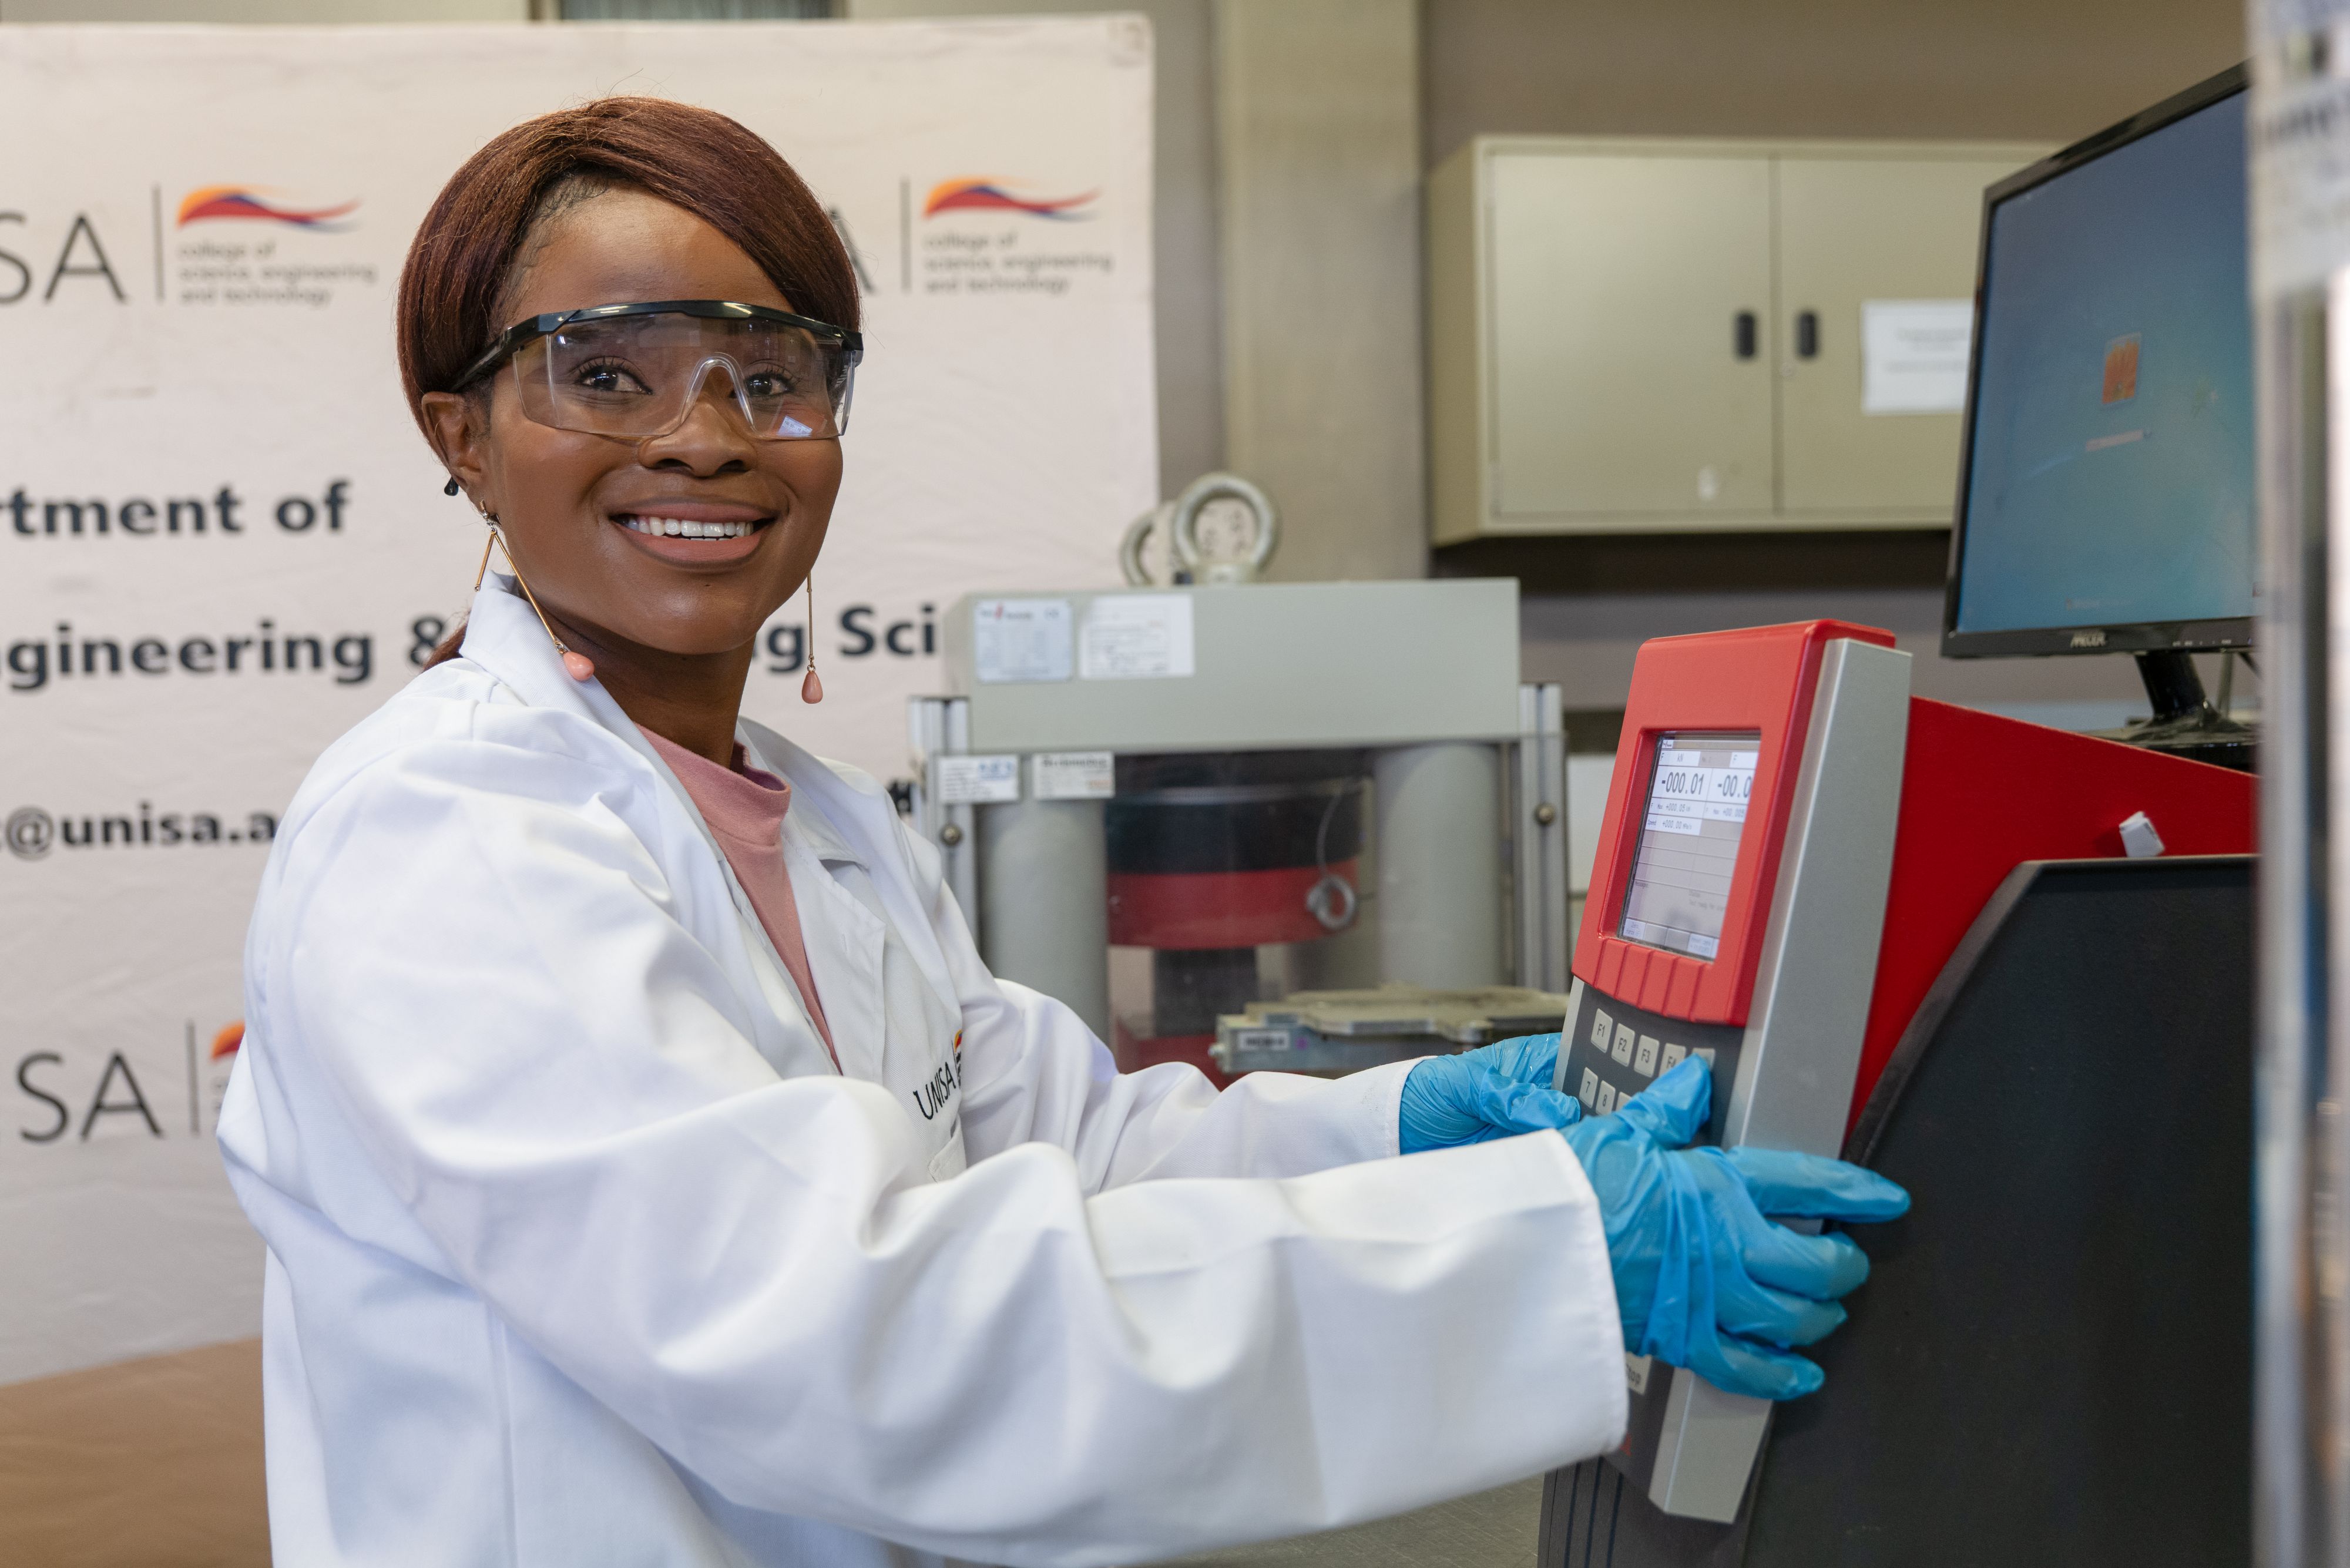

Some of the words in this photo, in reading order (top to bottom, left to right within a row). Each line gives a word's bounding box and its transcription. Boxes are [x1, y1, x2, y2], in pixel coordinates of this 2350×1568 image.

[274, 479, 349, 533] of
[0, 619, 374, 693] gineering
[838, 604, 936, 658] Sci
[1661, 772, 1704, 795] -000.01
[0, 802, 277, 859] @unisa.a
[1597, 1023, 1606, 1038] F1
[1617, 1038, 1627, 1052] F2
[1641, 1049, 1650, 1063] F3
[16, 1050, 163, 1143] SA
[912, 1062, 956, 1120] UNISA
[1586, 1081, 1591, 1093] 7
[1602, 1094, 1607, 1107] 8
